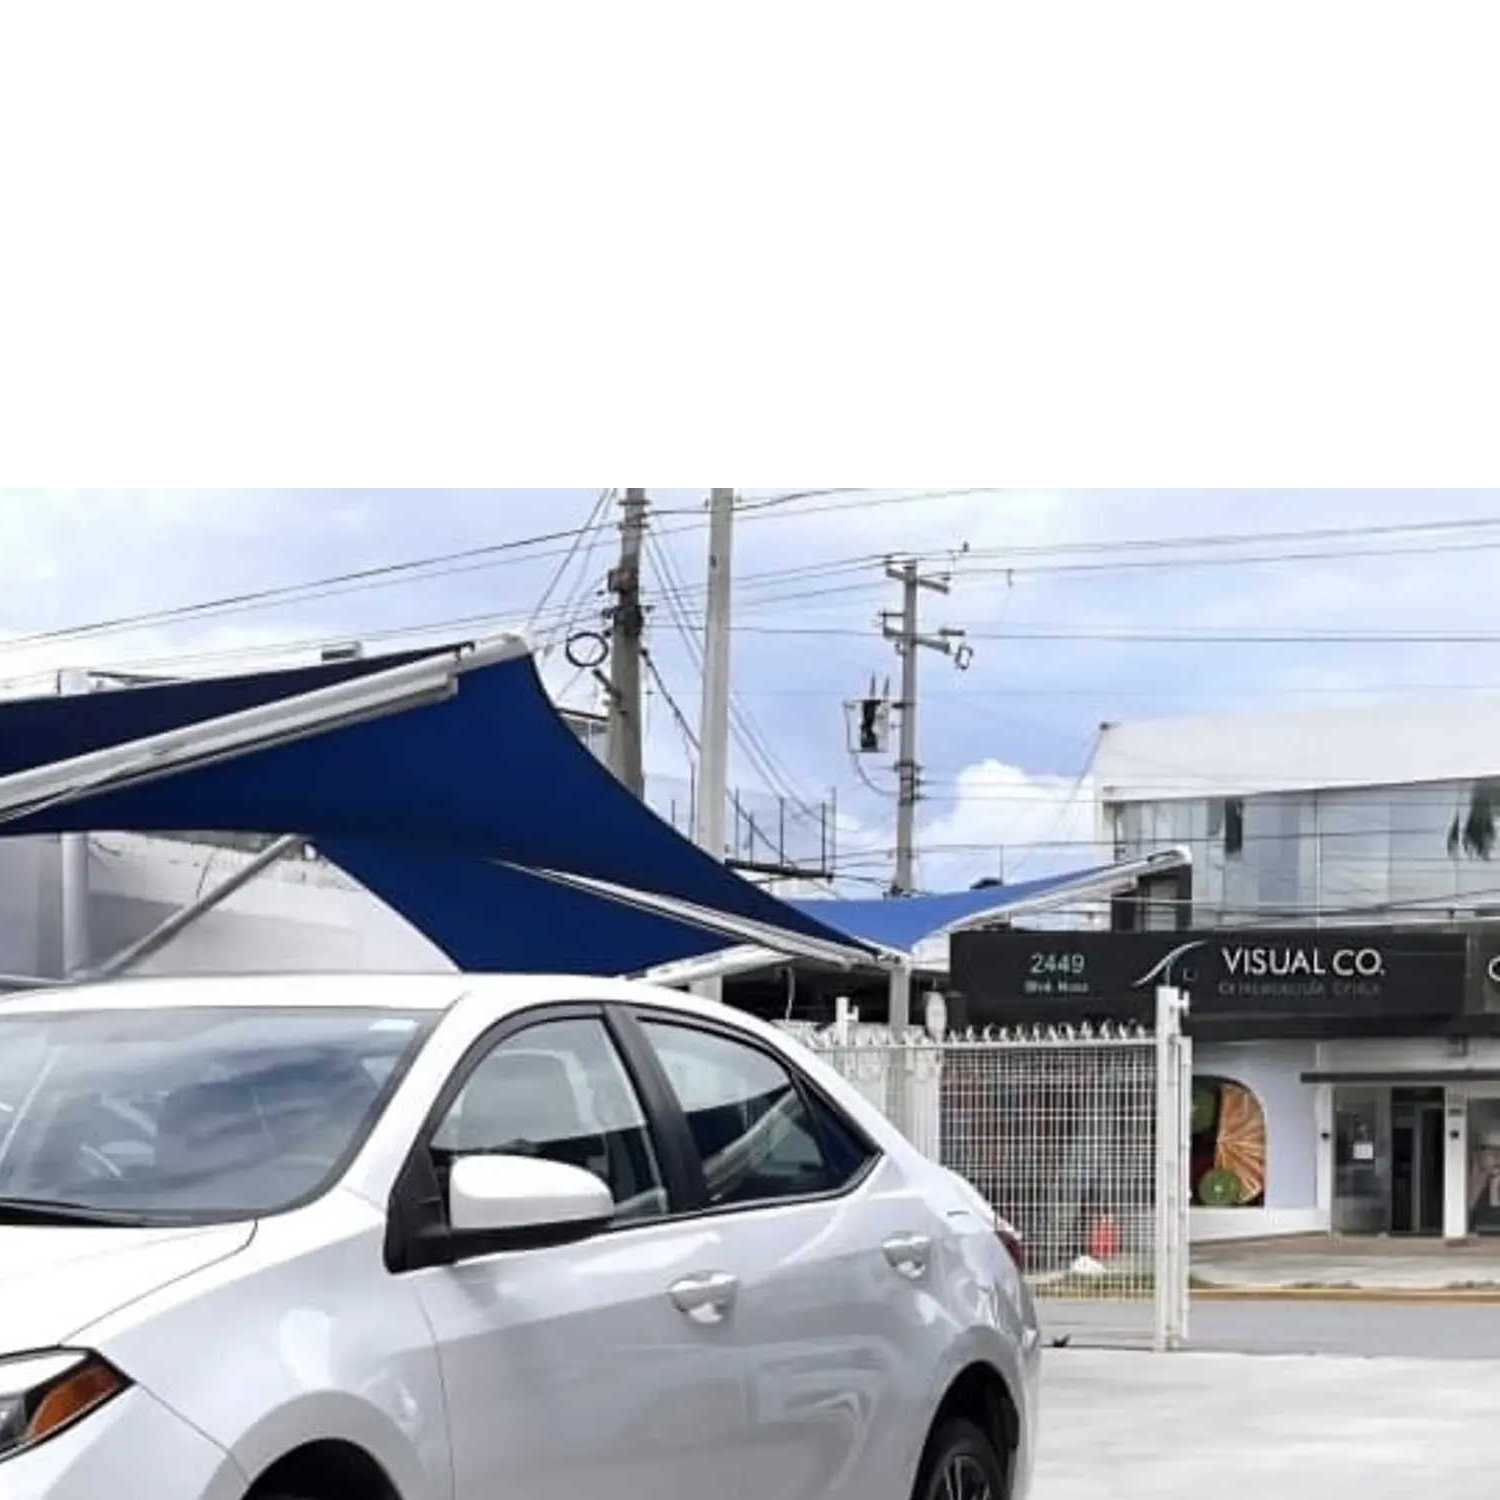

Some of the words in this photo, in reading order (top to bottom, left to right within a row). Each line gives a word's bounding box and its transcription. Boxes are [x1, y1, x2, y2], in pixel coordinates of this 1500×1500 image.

[1030, 952, 1085, 974] 2449
[1222, 947, 1326, 975] VISUAL
[1332, 948, 1385, 976] CO.
